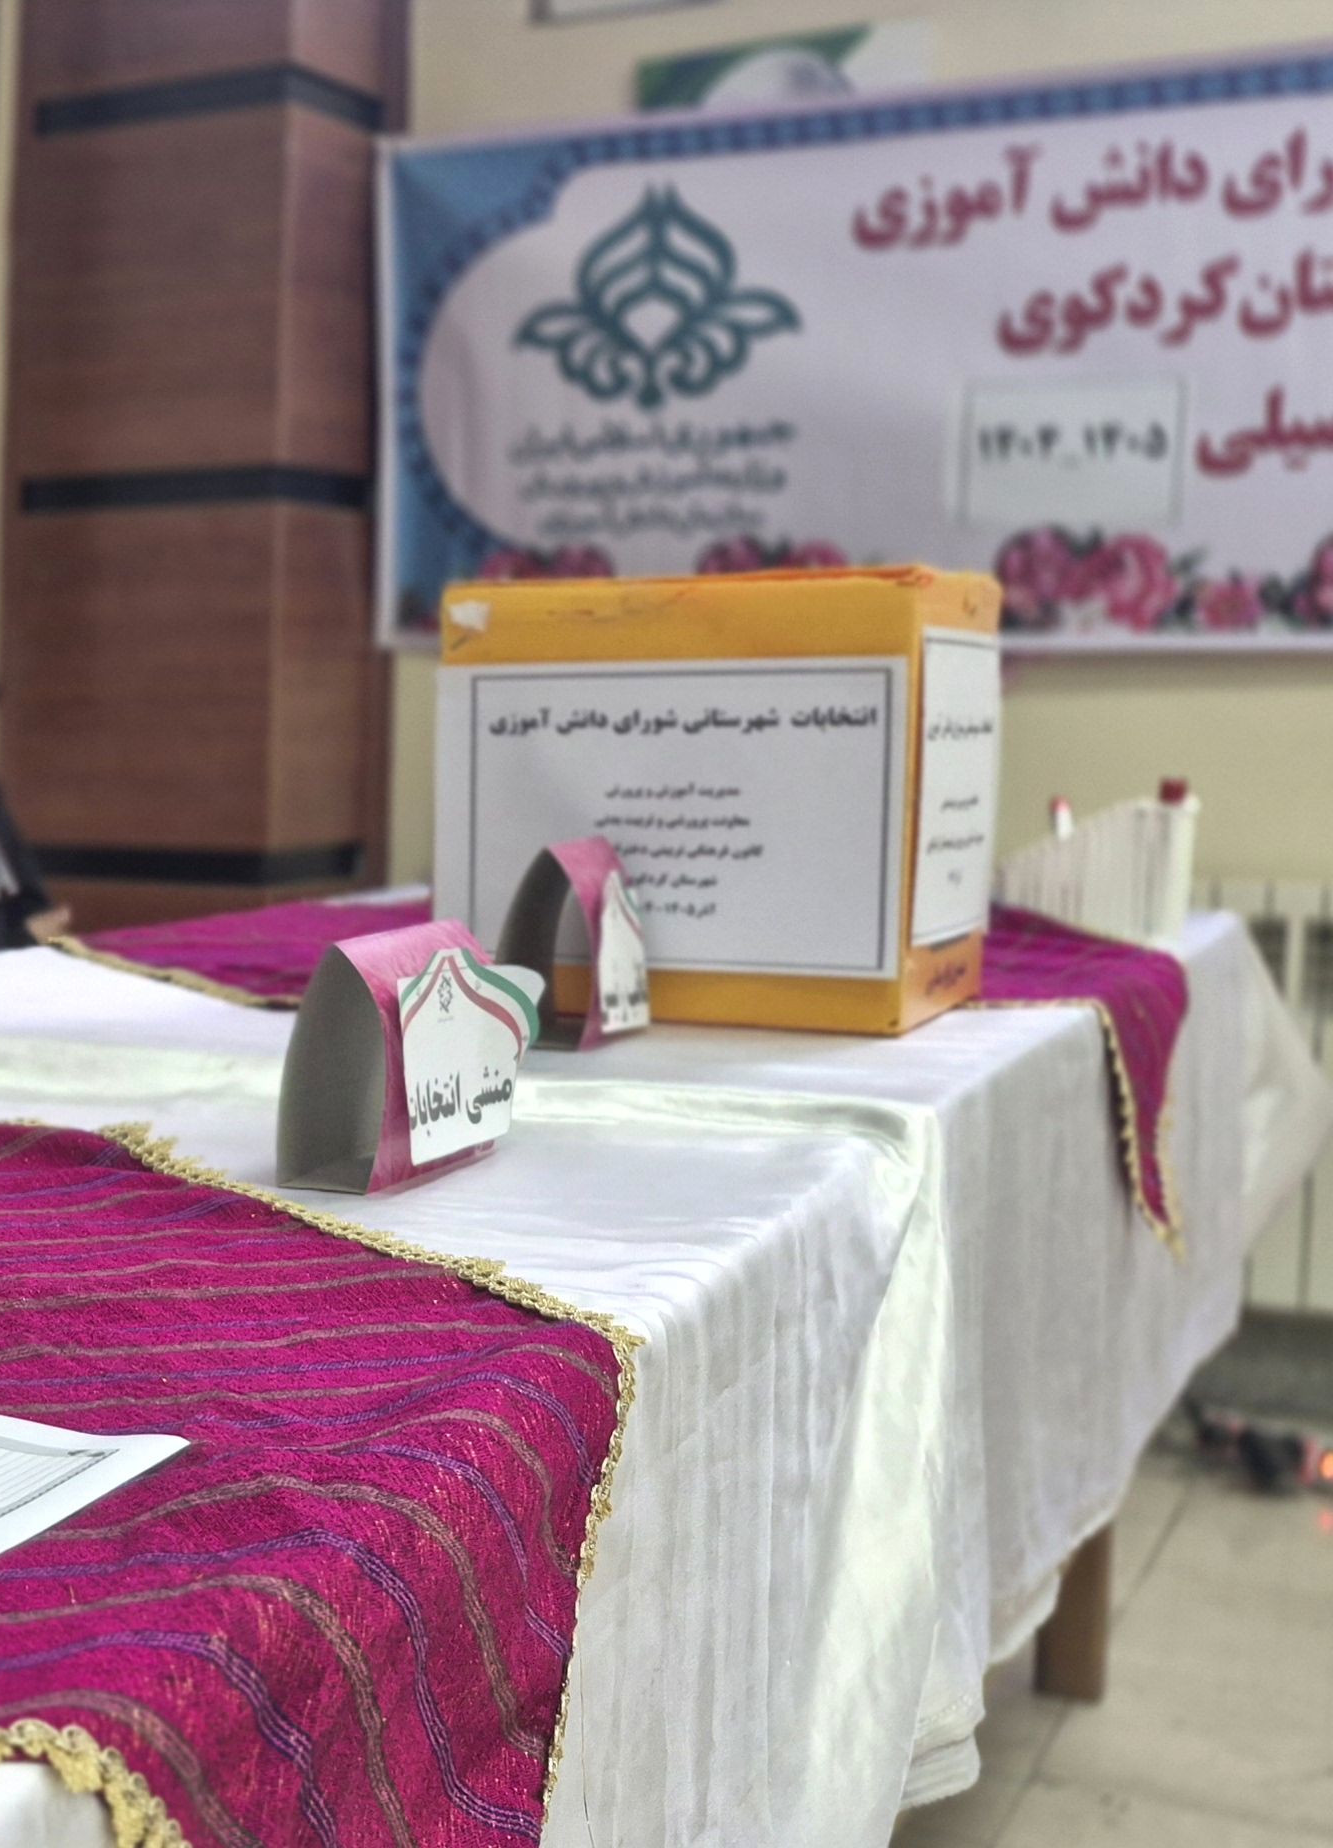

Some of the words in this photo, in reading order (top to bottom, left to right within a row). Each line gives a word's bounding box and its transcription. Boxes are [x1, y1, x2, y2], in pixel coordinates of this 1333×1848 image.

[851, 143, 1043, 251] آموزی
[1049, 139, 1209, 234] دانش
[994, 253, 1240, 357] کردکوی
[488, 707, 551, 737] آموزی
[555, 709, 609, 737] دانش
[612, 709, 679, 736] شورای
[681, 708, 780, 736] شهرستانی
[790, 706, 878, 732] انتخابات
[466, 1065, 513, 1124] منشی
